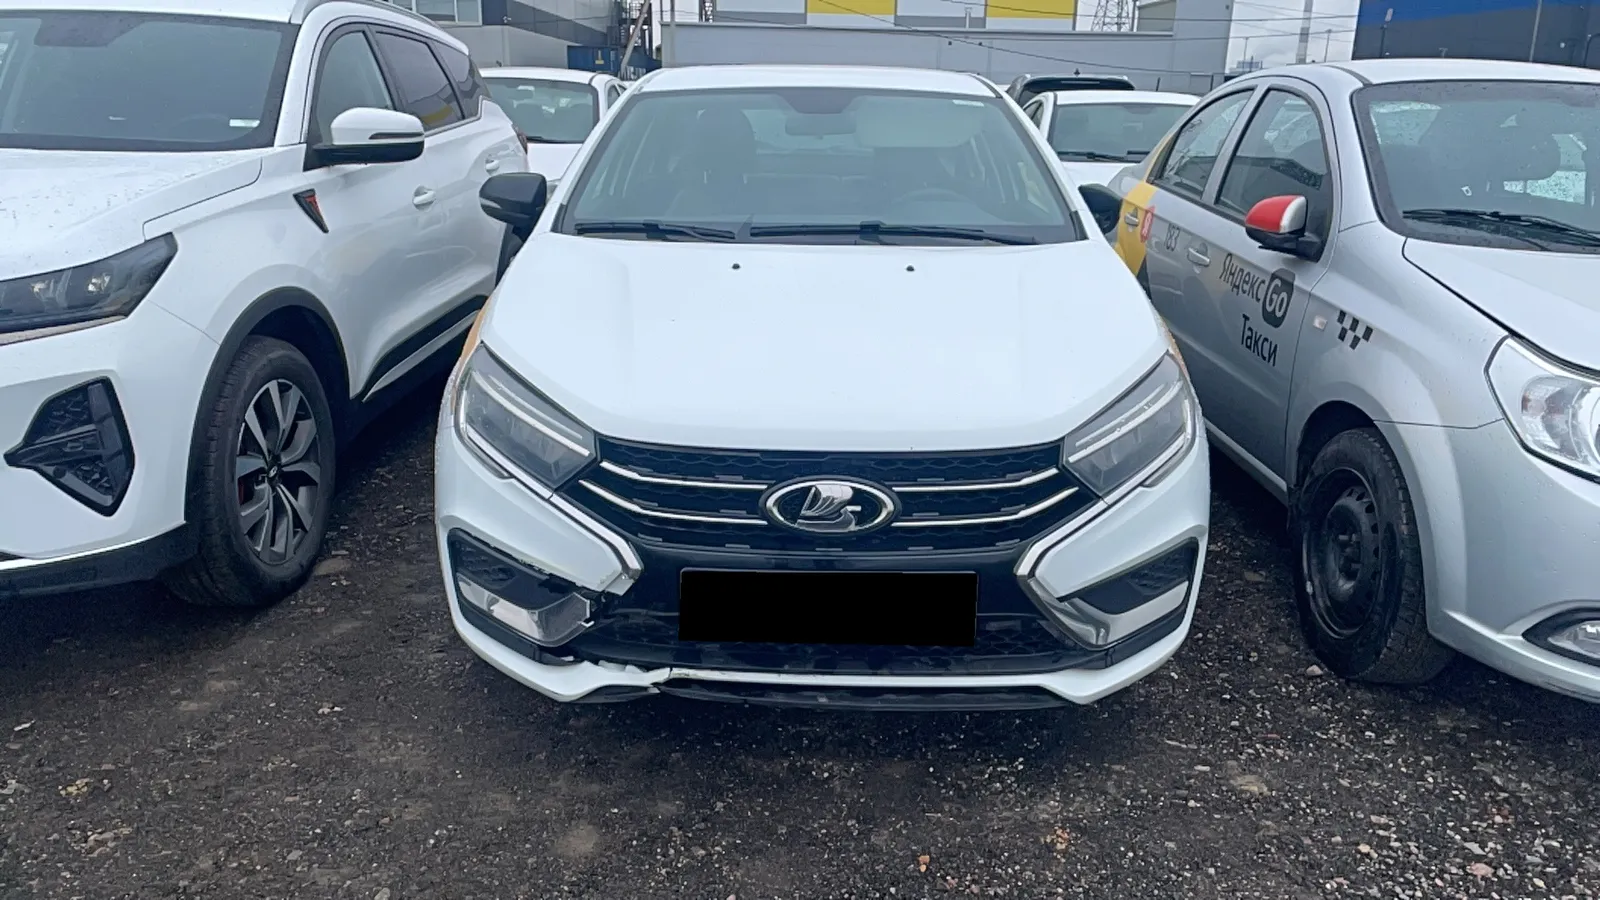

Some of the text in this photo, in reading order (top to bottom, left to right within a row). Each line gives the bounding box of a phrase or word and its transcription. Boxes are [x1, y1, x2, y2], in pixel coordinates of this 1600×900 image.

[1218, 253, 1288, 318] Яндекс Go
[1241, 313, 1278, 367] Такси
